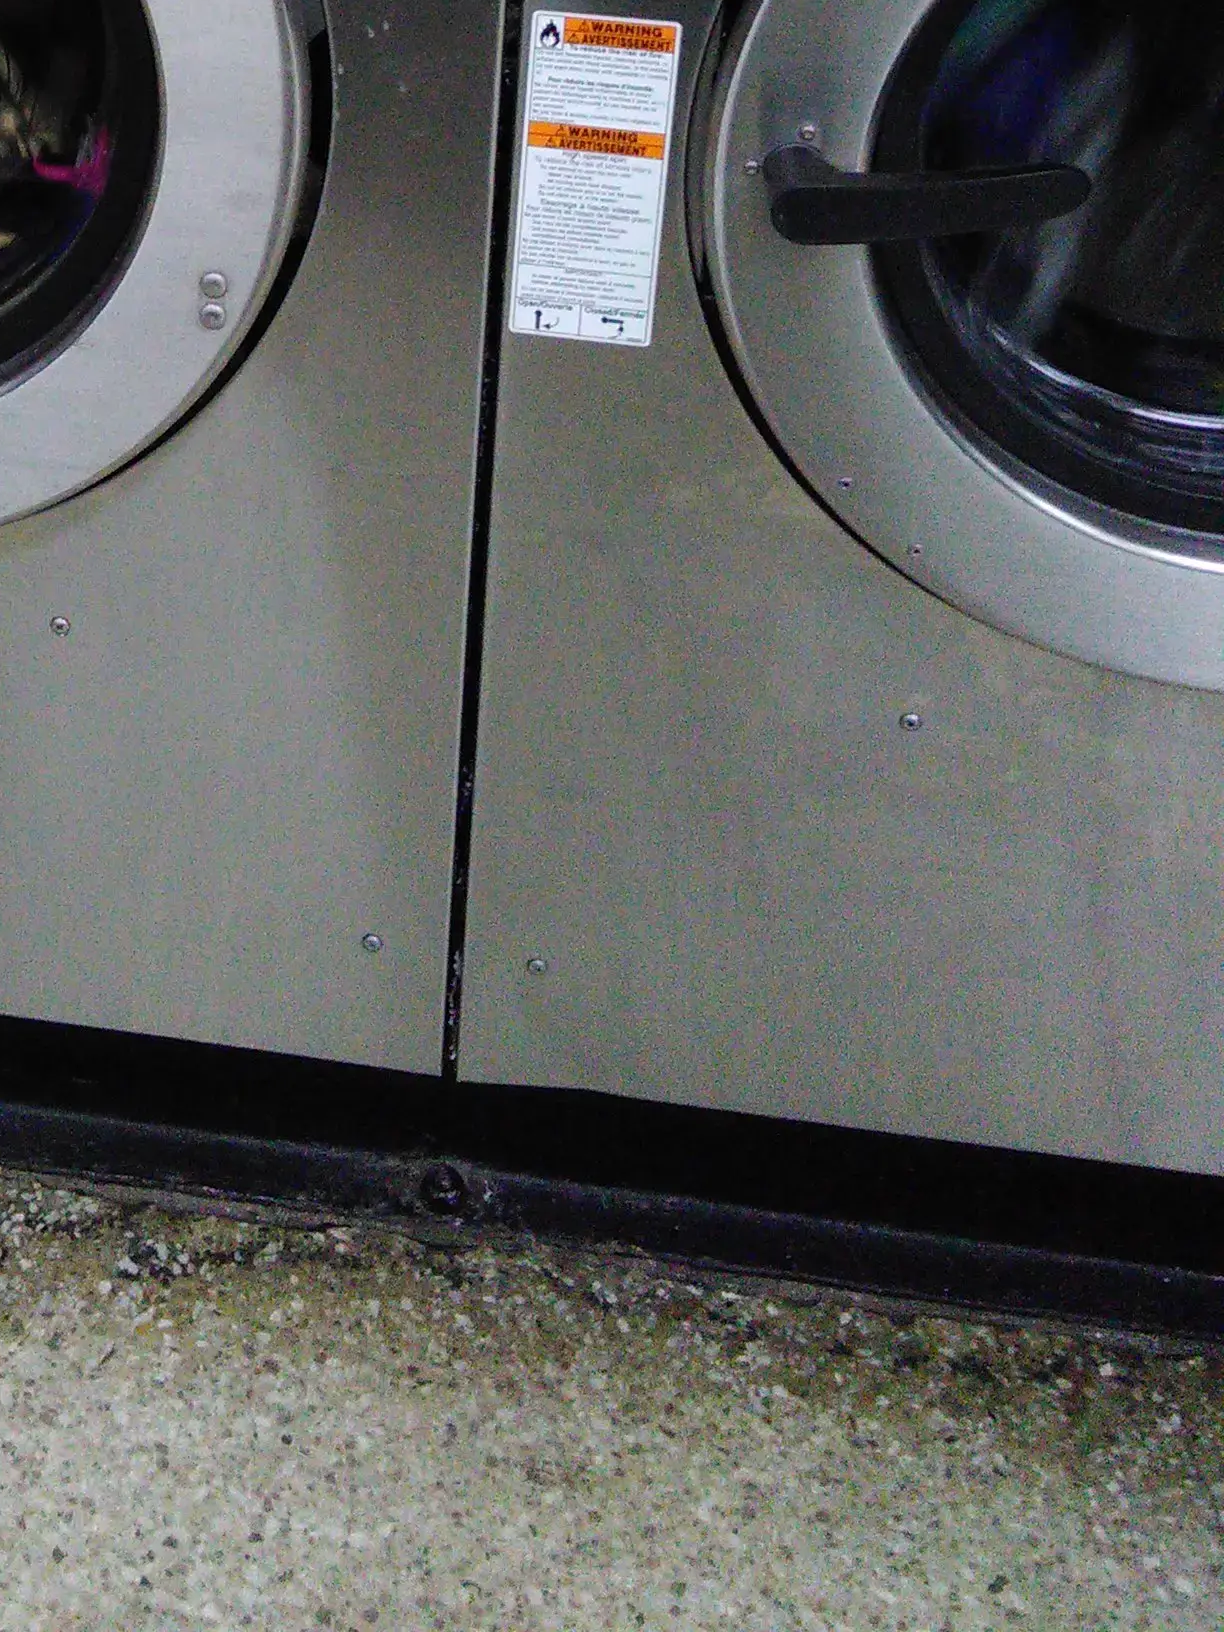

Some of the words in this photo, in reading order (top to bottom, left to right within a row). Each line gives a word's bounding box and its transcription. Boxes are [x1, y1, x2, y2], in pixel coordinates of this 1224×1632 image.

[590, 21, 663, 38] WARNING
[582, 35, 671, 51] AVERTISSEMENT
[568, 125, 639, 144] WARNING
[559, 138, 647, 156] AVERTISSEMENT
